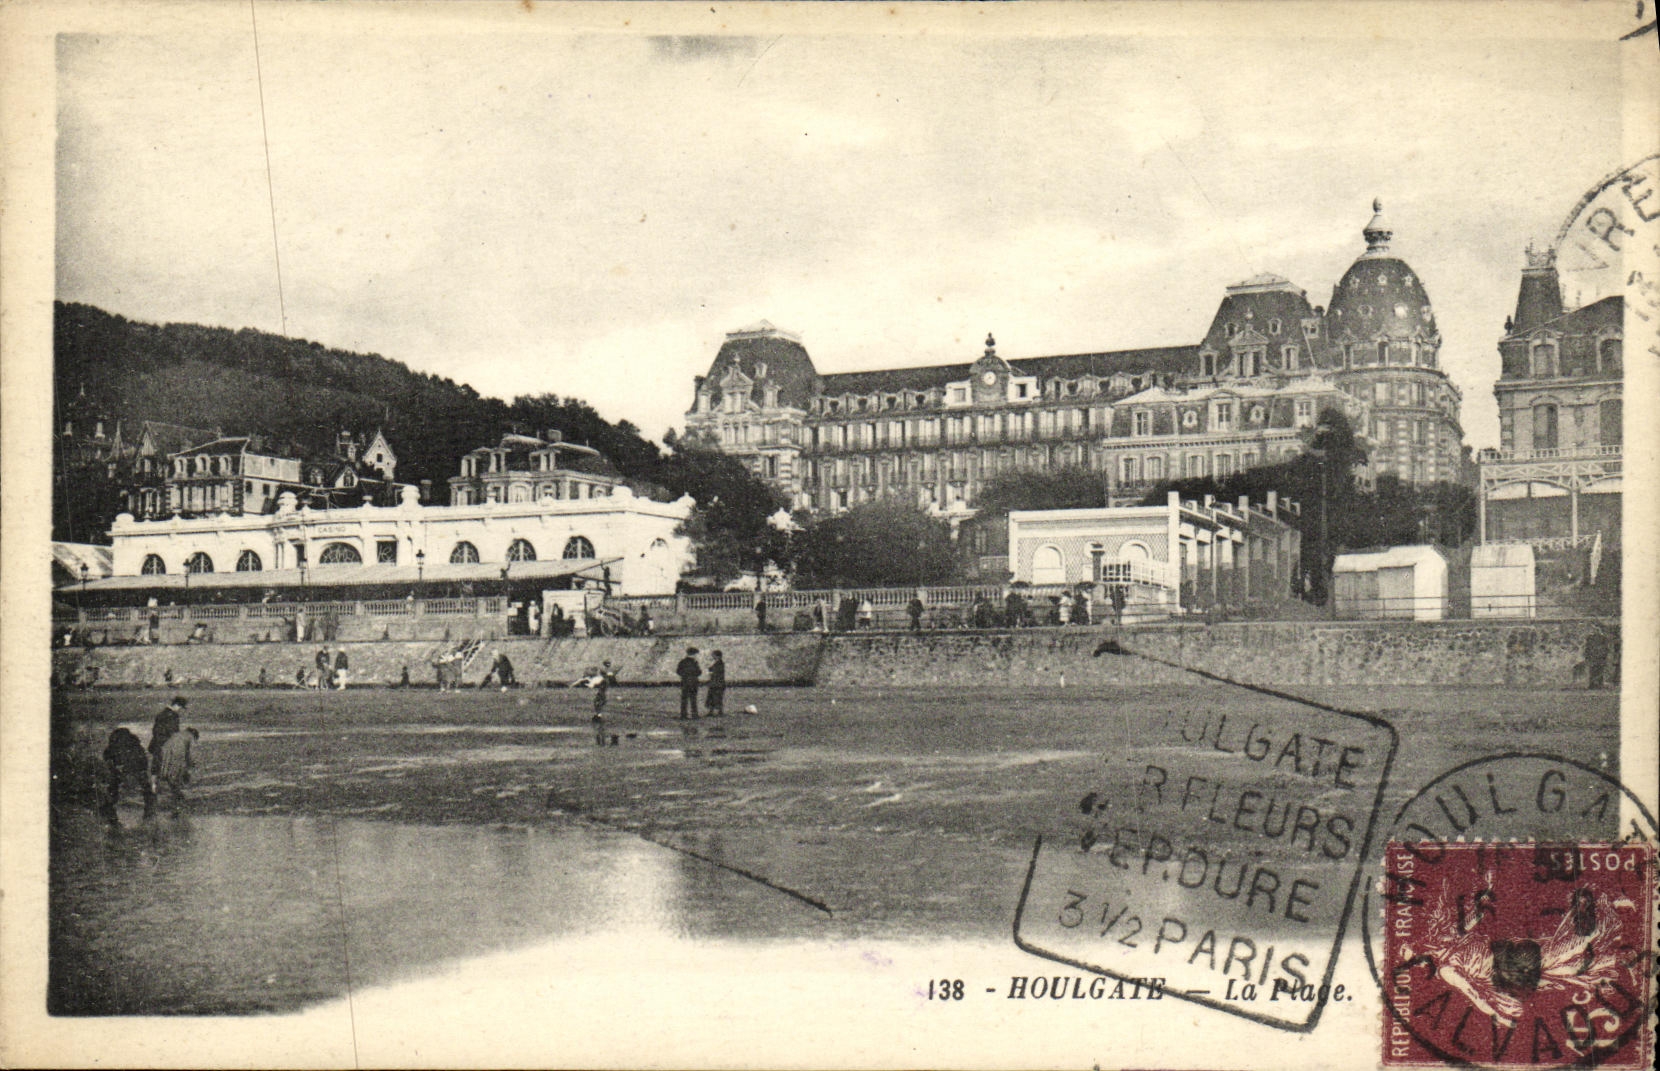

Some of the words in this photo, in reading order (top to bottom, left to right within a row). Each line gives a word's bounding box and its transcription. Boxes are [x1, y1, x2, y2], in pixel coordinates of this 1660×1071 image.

[317, 525, 347, 534] CASINO
[1181, 775, 1355, 860] FLEURS
[1058, 889, 1088, 929] 3
[1153, 917, 1311, 994] PARIS
